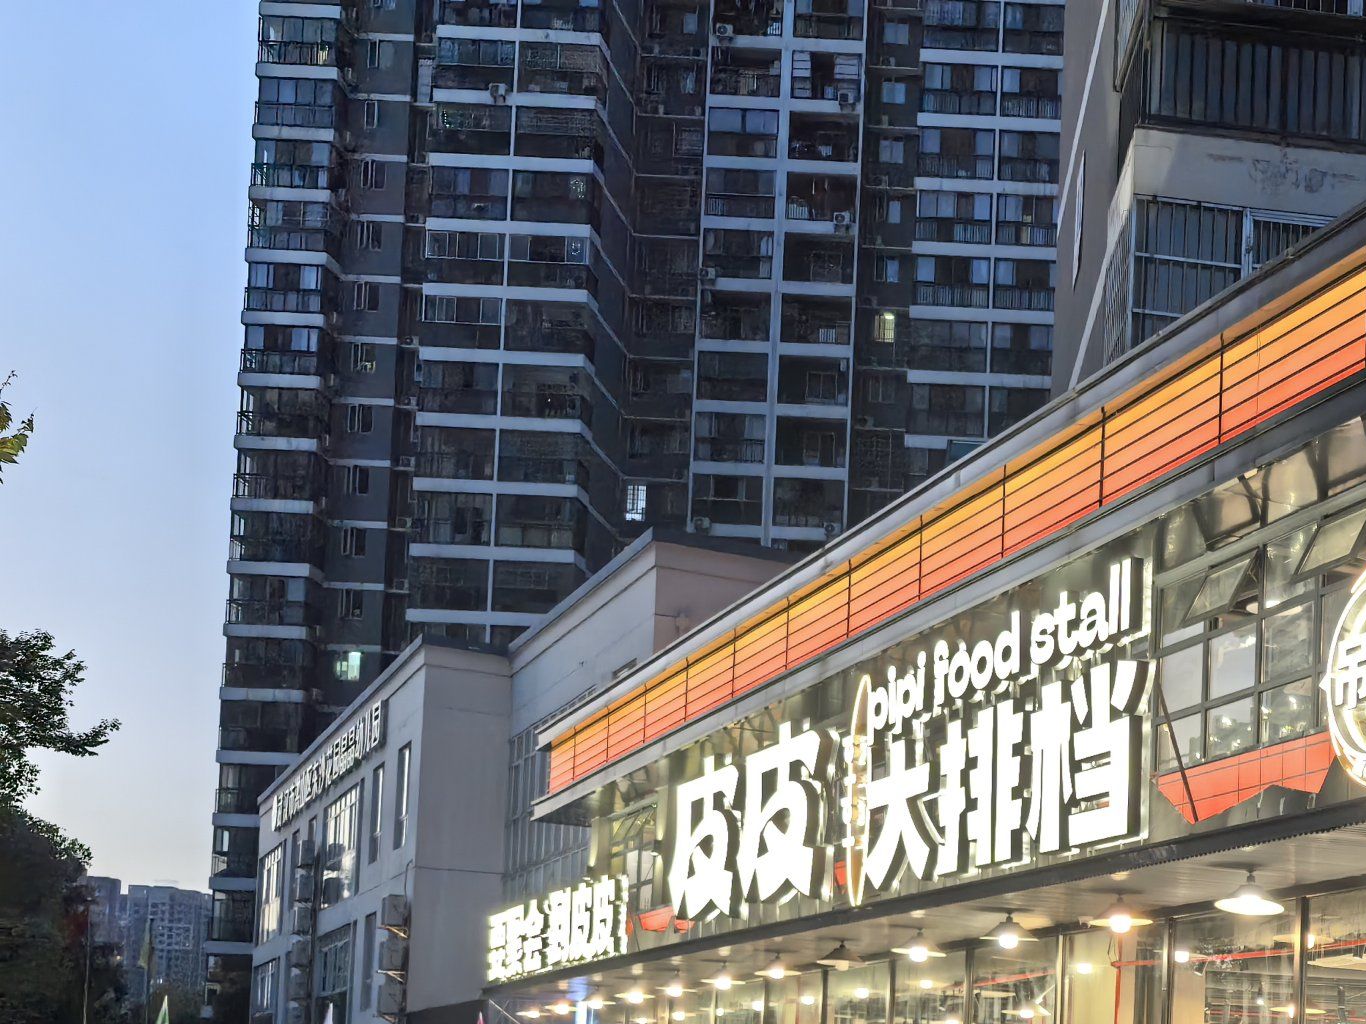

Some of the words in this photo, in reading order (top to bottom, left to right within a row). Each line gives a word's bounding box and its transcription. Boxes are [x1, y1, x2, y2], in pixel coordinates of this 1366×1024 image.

[870, 651, 925, 735] pipi
[933, 610, 1020, 706] food
[1030, 557, 1131, 664] stall
[668, 724, 823, 919] 皮皮
[864, 661, 1138, 889] 大排档
